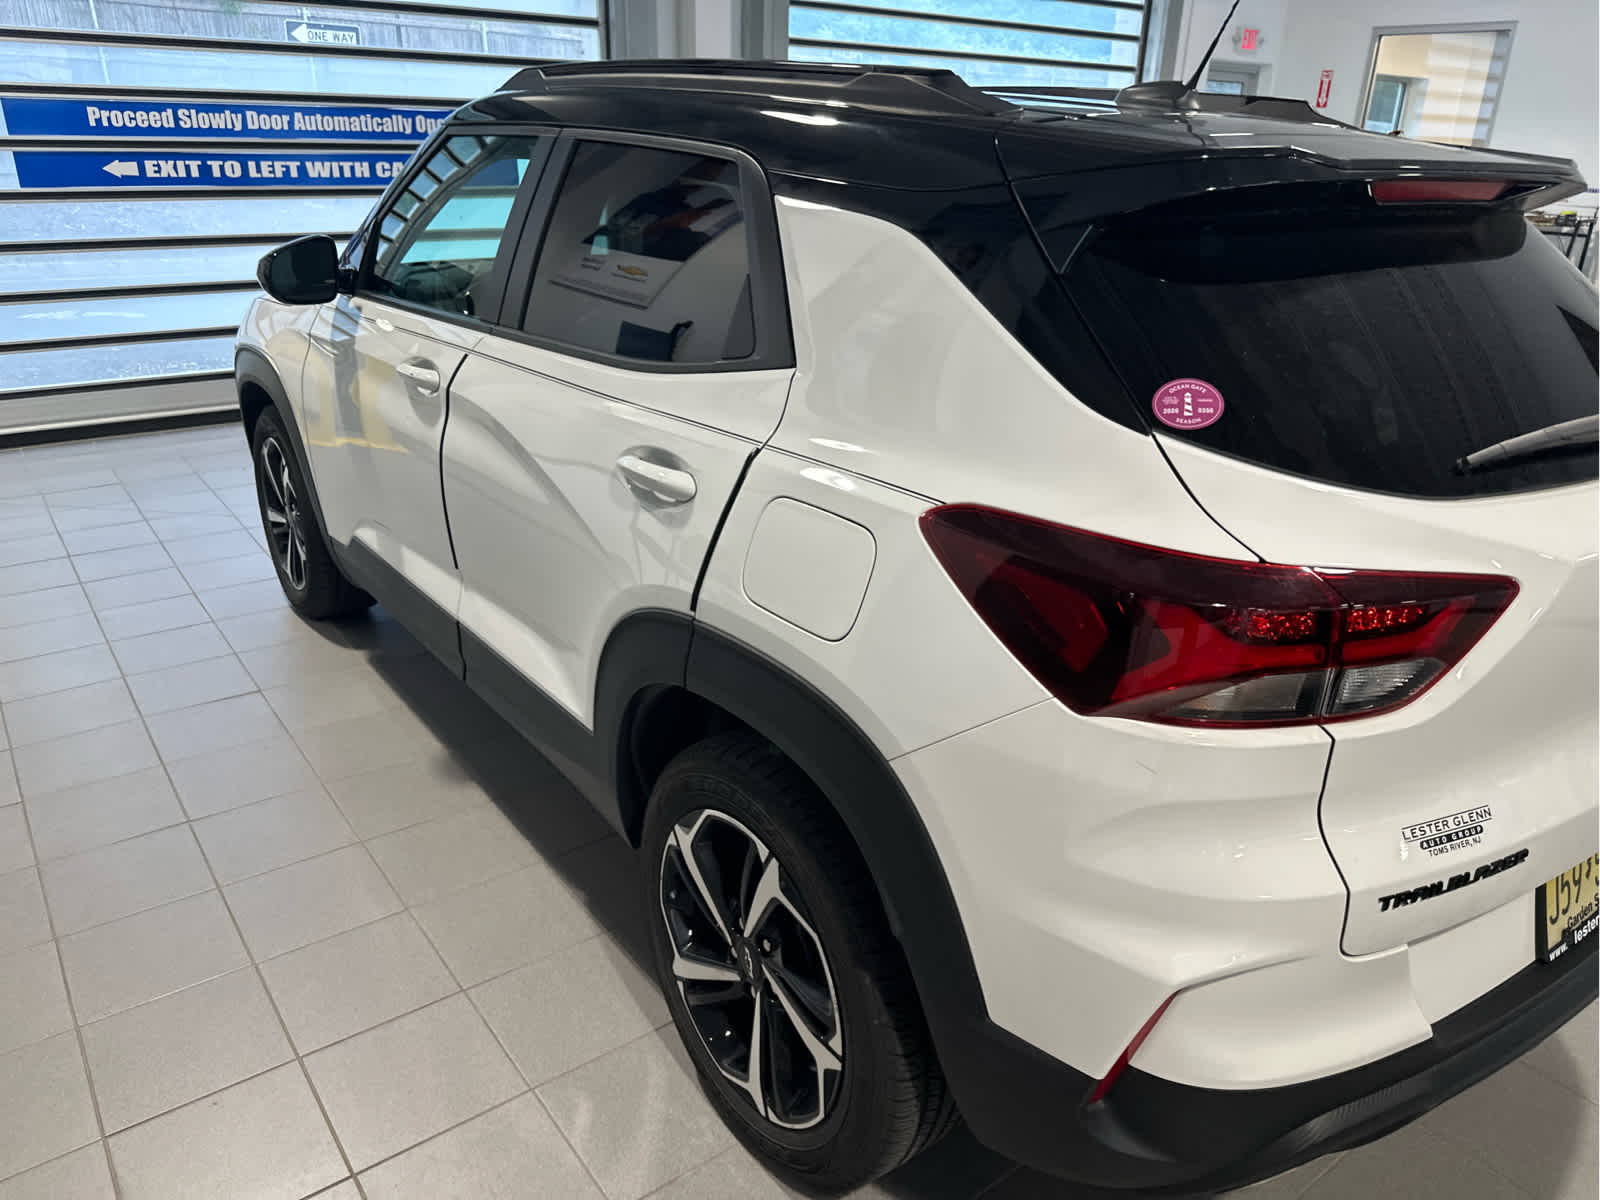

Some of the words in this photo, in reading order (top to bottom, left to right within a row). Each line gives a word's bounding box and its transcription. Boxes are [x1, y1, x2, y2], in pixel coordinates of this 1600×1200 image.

[307, 30, 328, 41] ONE
[333, 32, 354, 43] WAY
[86, 106, 175, 128] Proceed
[178, 108, 242, 131] Slowly
[246, 111, 290, 131] Door
[294, 112, 413, 135] Automatically
[144, 160, 202, 178] EXIT
[206, 160, 242, 178] TO
[248, 161, 301, 178] LEFT
[305, 162, 371, 178] WITH
[375, 162, 404, 178] CA
[1168, 384, 1190, 394] OCEAN
[1190, 384, 1207, 394] GATE
[1175, 417, 1202, 425] SEASON
[1402, 820, 1450, 841] LESTER
[1452, 808, 1492, 828] GLENN
[1421, 836, 1448, 849] AUTO
[1451, 825, 1483, 840] GROUP
[1428, 845, 1449, 857] TOMS
[1449, 839, 1474, 851] RIVER,
[1472, 836, 1482, 845] NJ
[1378, 848, 1530, 912] TRAILBLAZER
[1567, 901, 1593, 929] Garden
